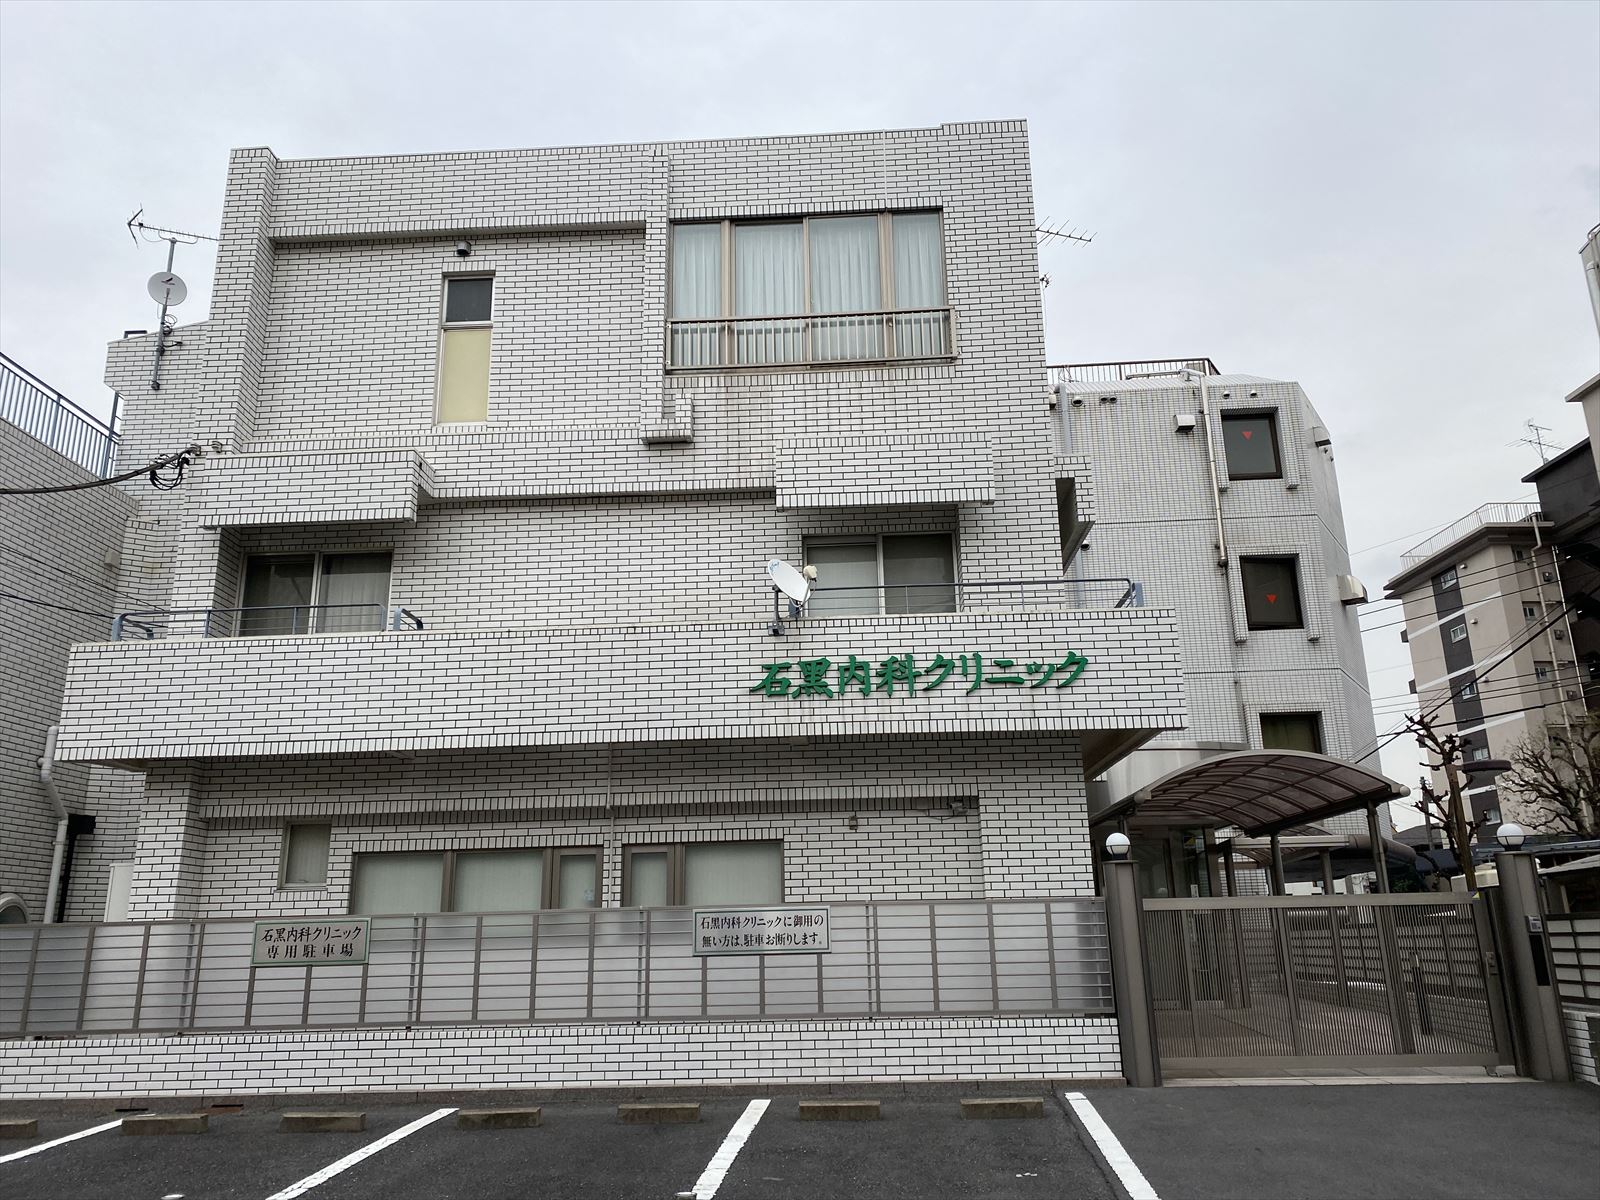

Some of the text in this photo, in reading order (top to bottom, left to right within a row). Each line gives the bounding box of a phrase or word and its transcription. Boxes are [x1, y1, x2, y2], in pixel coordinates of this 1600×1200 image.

[751, 651, 1088, 699] 石黒内科クリニック
[701, 914, 823, 930] 石黒内科クリニックに御用の
[262, 926, 361, 943] 石黒内科クリニック
[267, 943, 354, 959] 専用駐車場
